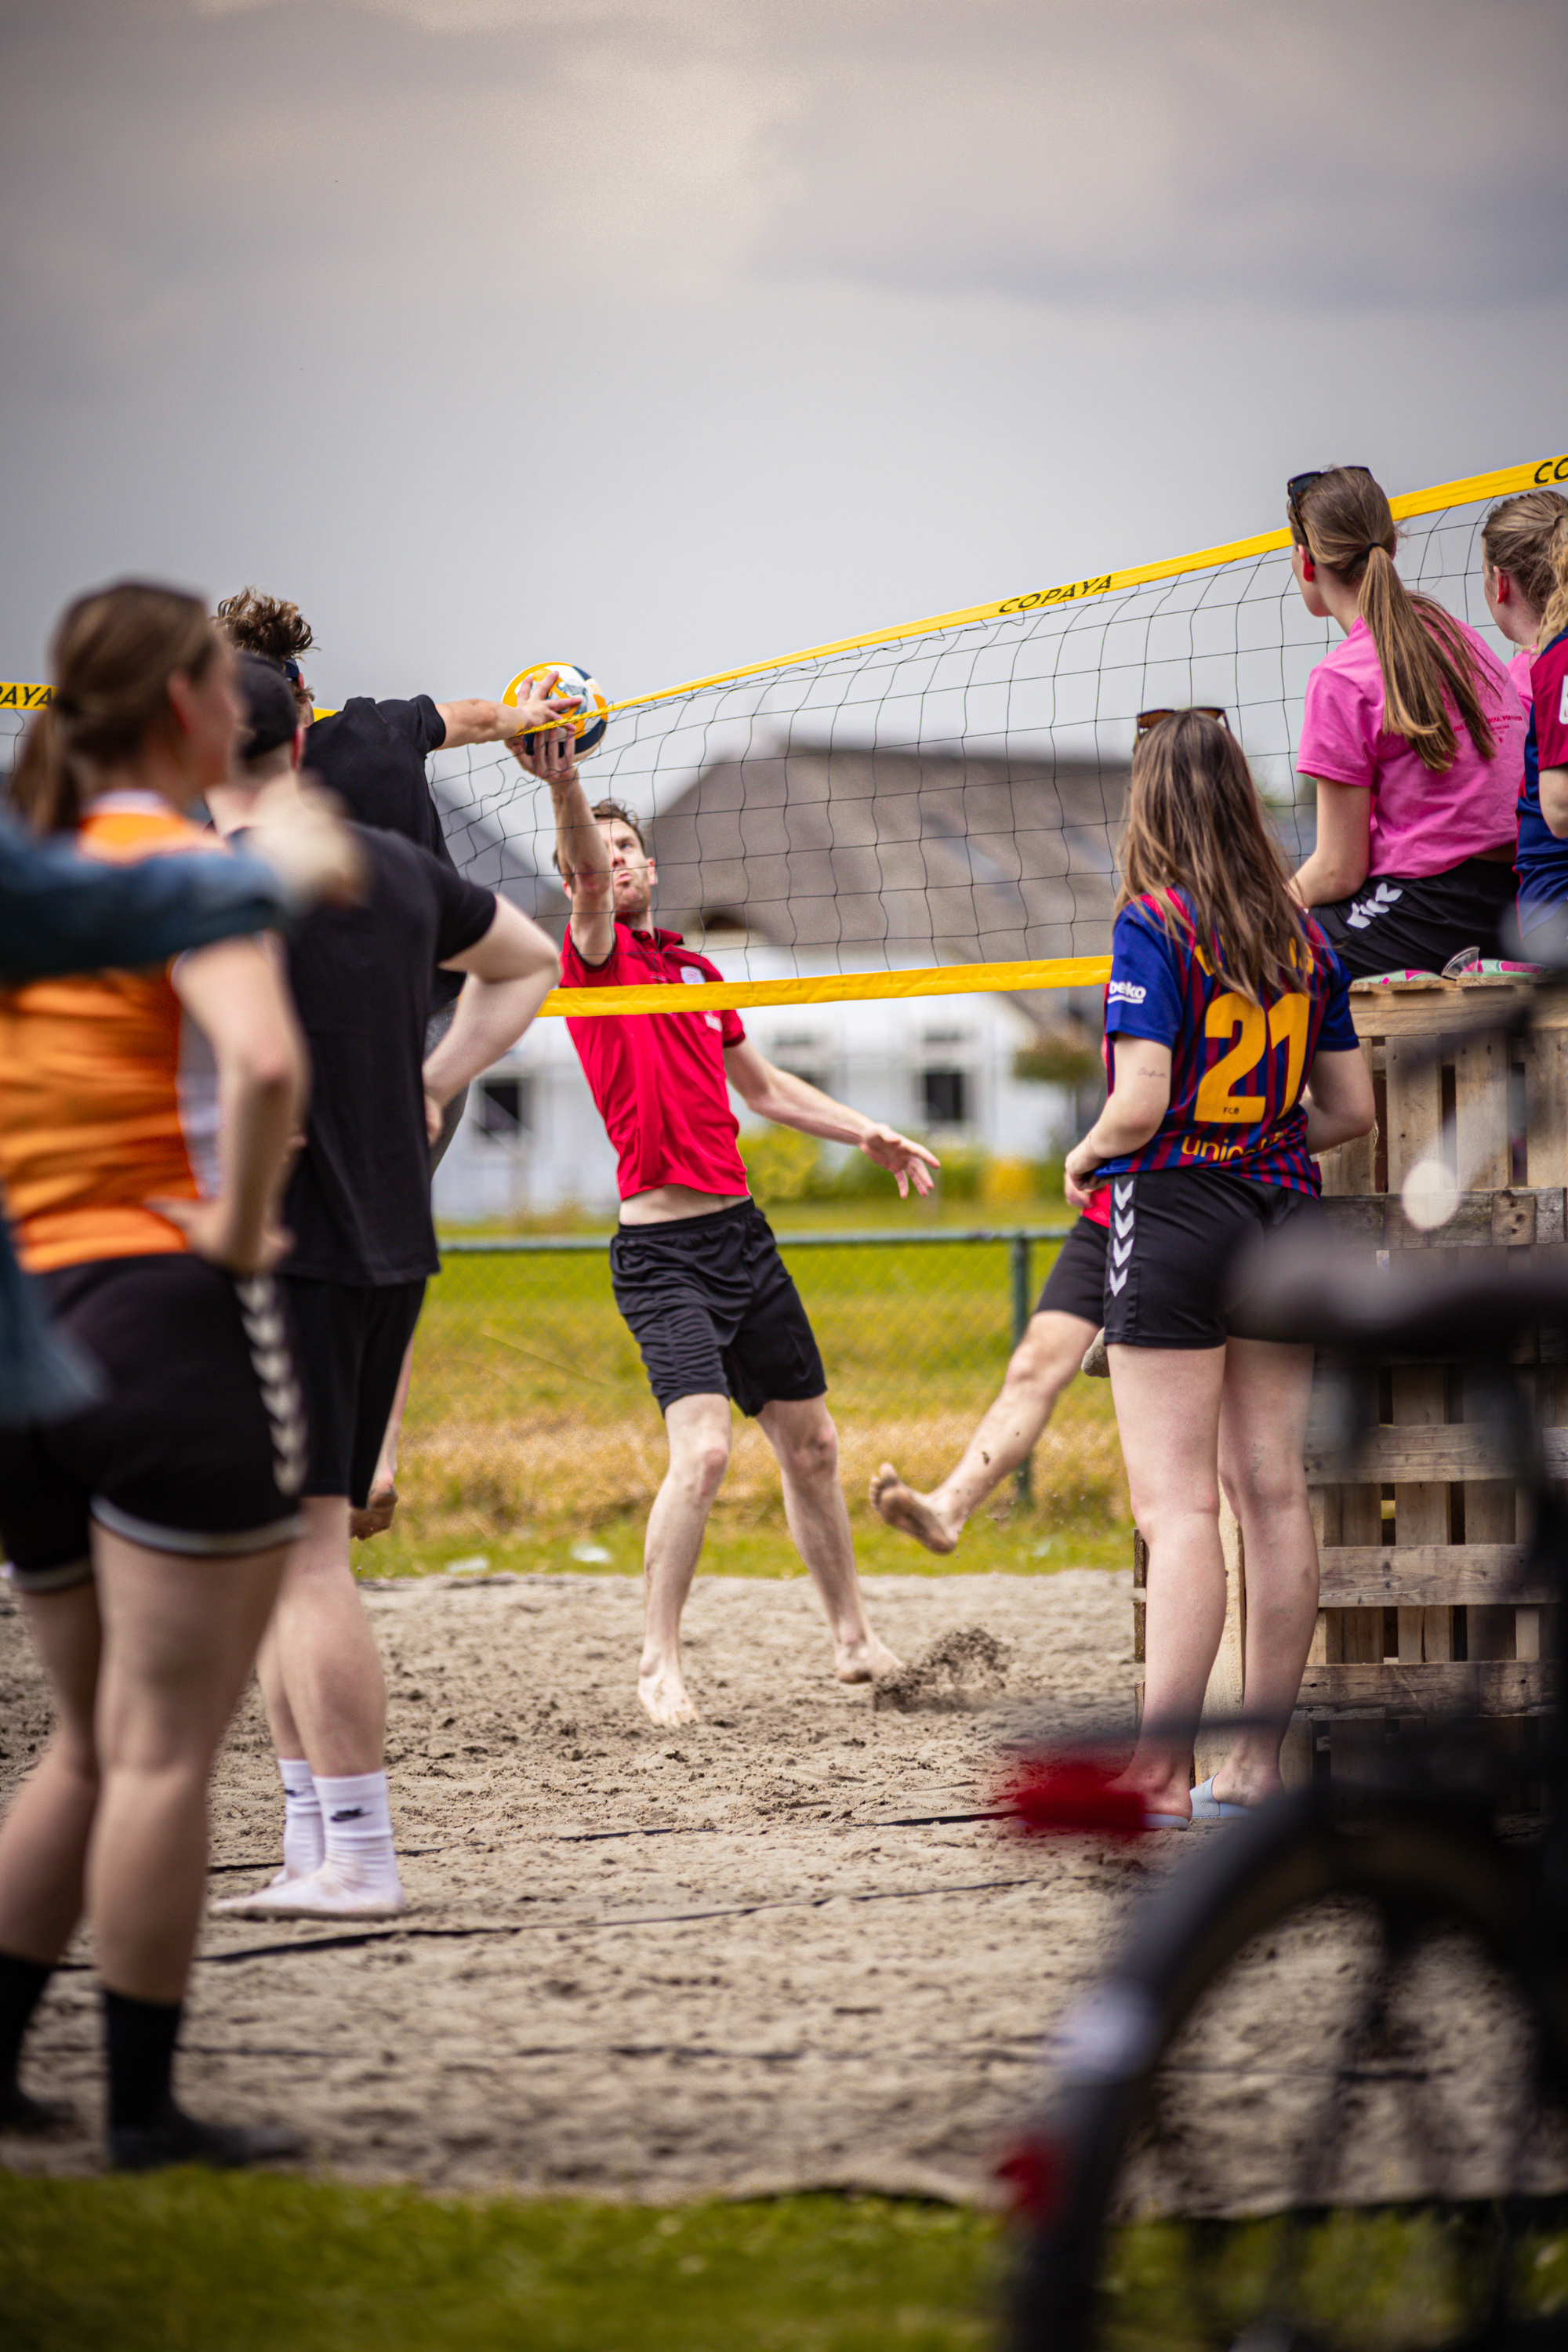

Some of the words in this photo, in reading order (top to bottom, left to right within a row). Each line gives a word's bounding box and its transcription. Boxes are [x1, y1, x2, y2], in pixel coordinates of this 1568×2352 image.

[999, 575, 1112, 613] COPAYA
[0, 685, 53, 707] AYA
[1109, 980, 1147, 1000] beko
[1194, 992, 1310, 1123] 21
